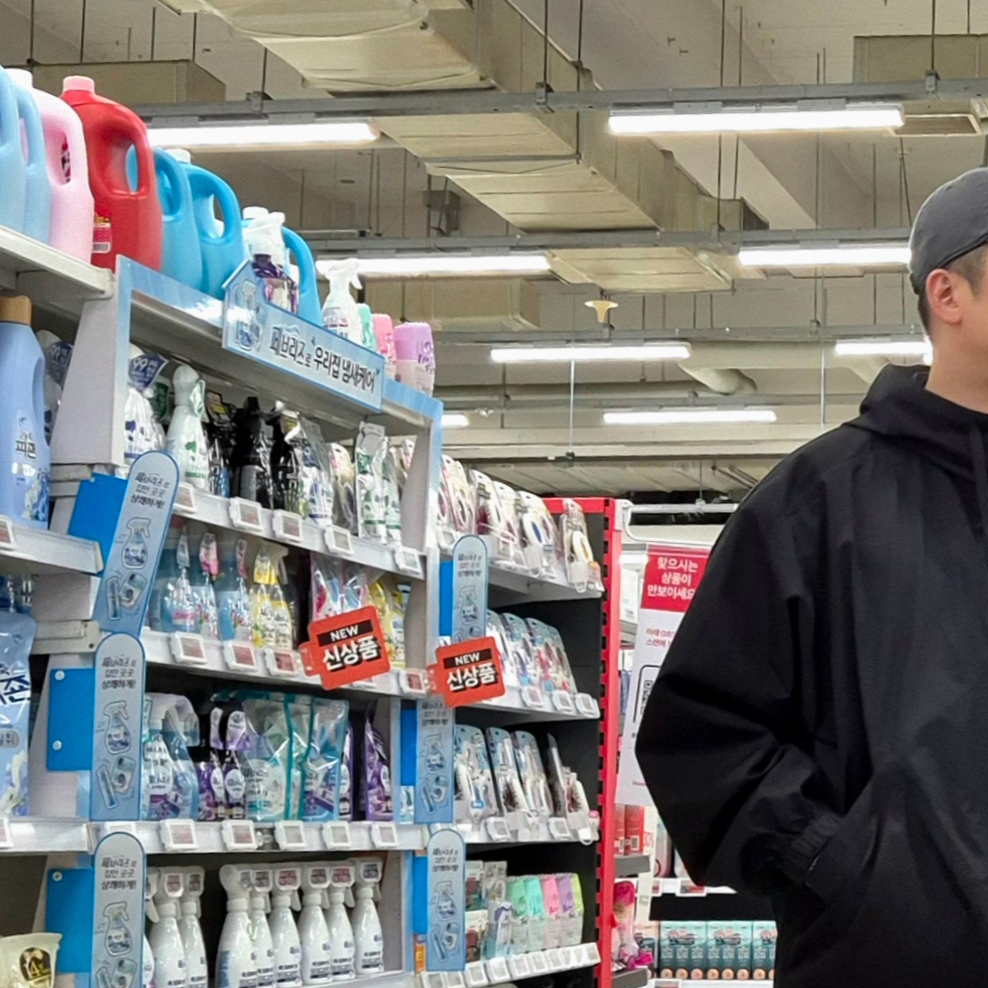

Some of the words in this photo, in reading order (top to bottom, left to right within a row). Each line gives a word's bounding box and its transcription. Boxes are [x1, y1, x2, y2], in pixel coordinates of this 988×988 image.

[313, 346, 341, 379] 우리집
[657, 556, 699, 573] 찾으시는
[661, 571, 692, 587] 상품이
[330, 624, 359, 642] NEW
[323, 635, 380, 672] 신상품
[454, 652, 480, 666] NEW
[447, 662, 497, 692] 신상품
